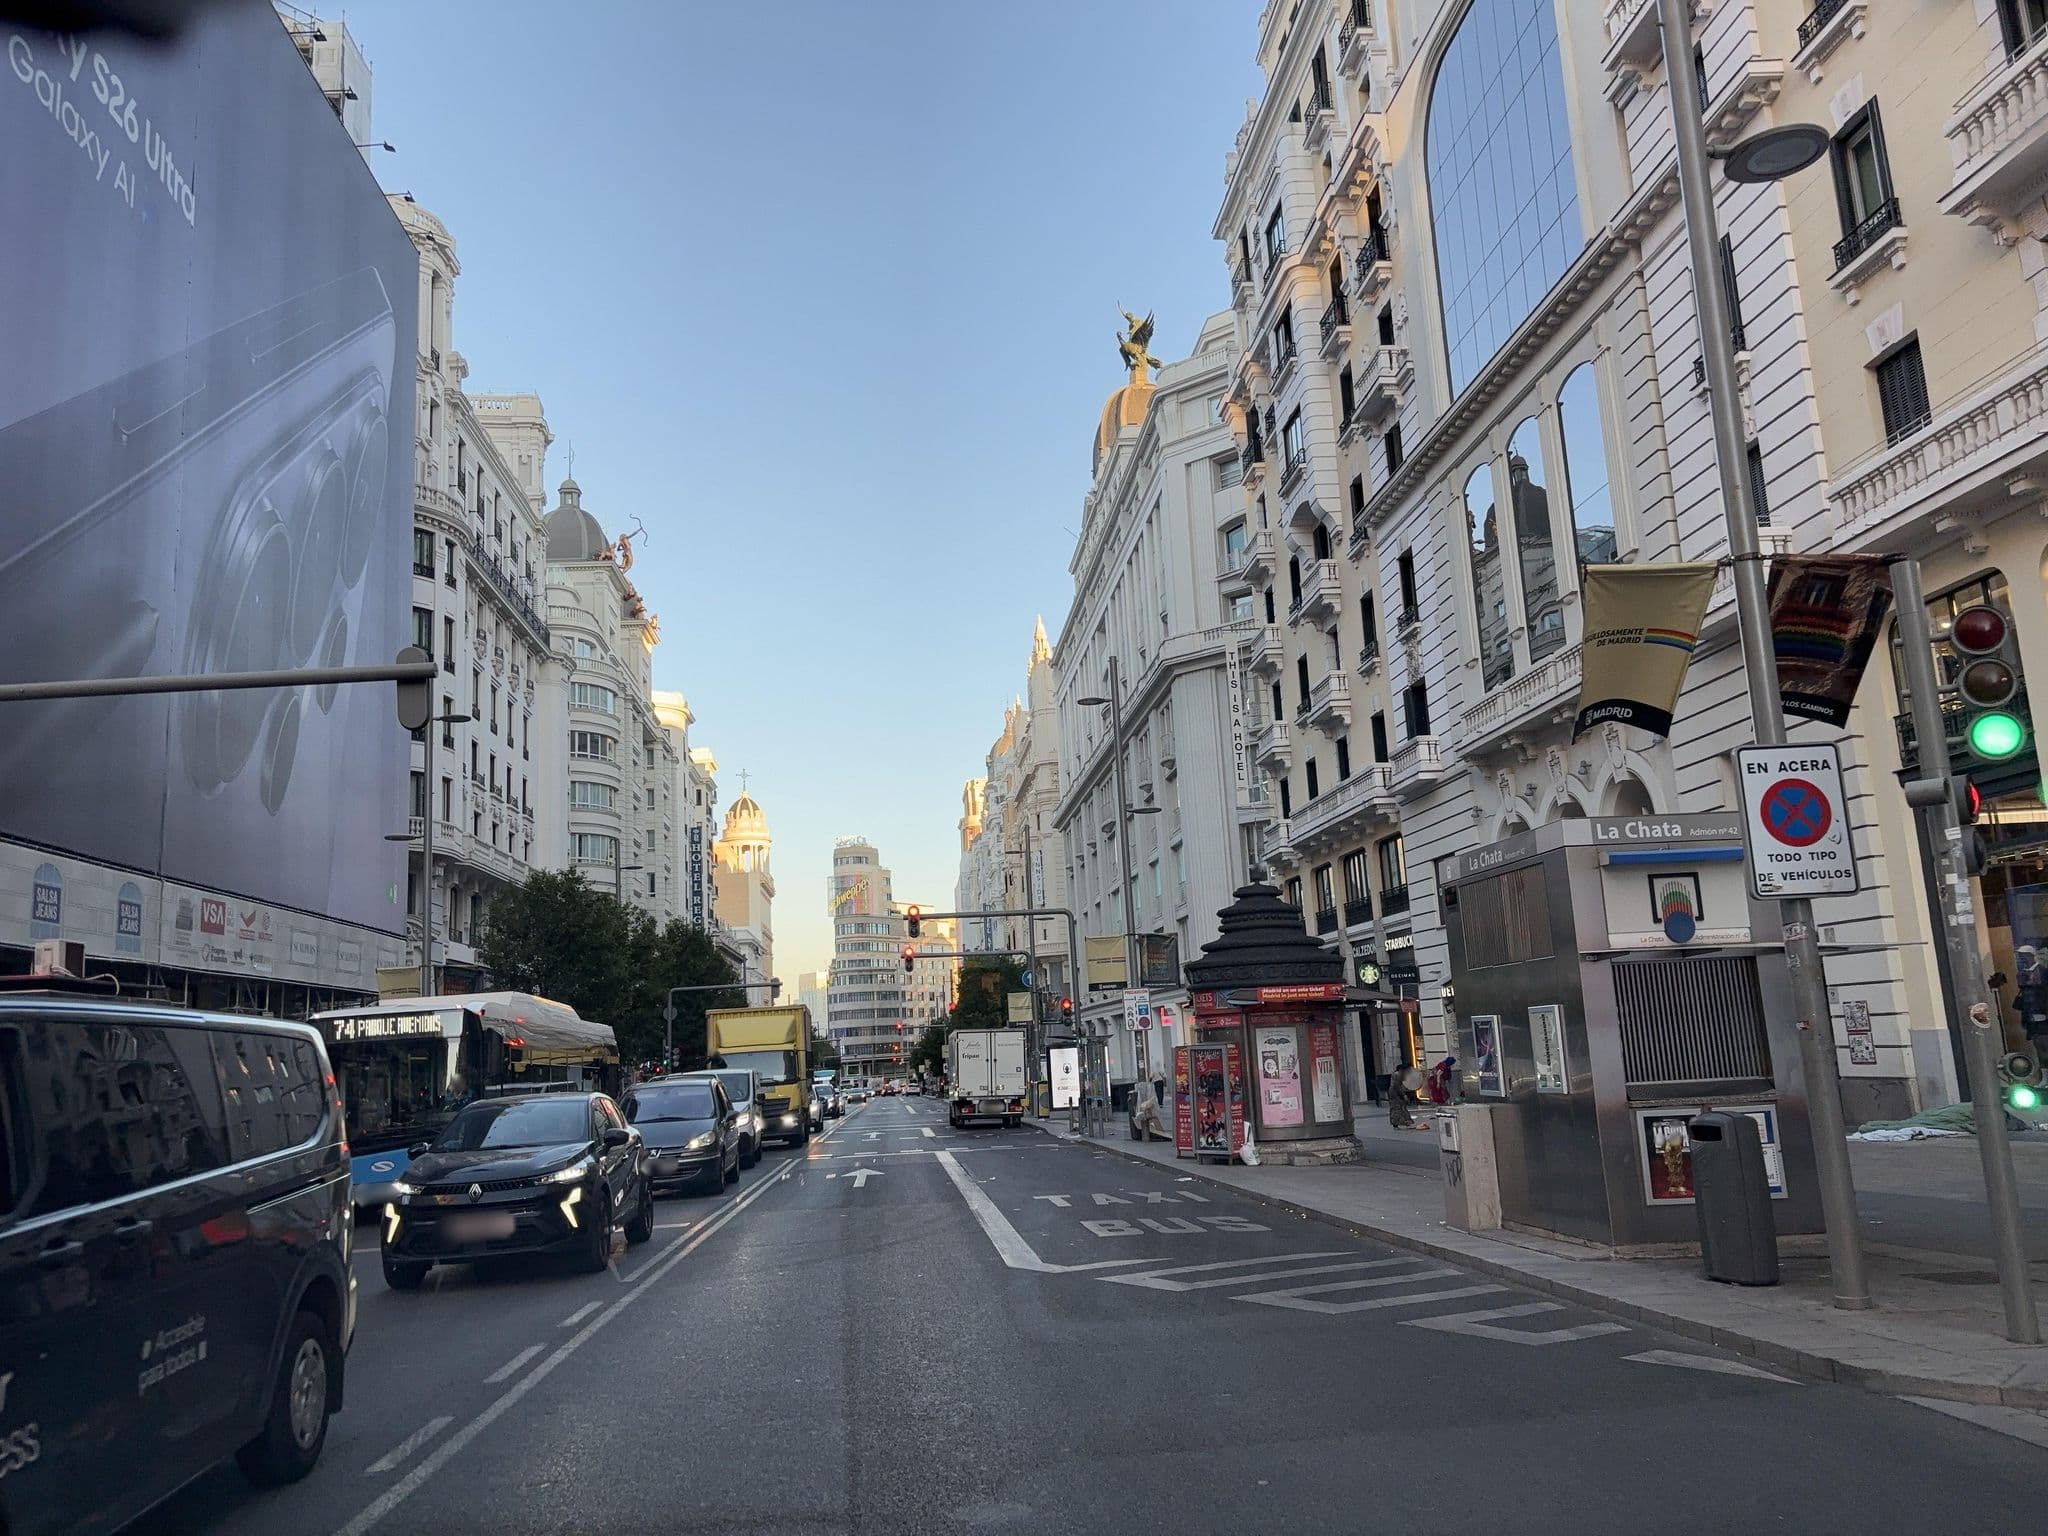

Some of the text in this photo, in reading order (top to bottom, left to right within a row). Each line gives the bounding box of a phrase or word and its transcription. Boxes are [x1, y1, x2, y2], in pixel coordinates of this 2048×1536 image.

[9, 34, 110, 182] Galaxy
[114, 160, 135, 209] AI
[92, 53, 196, 226] S26 Ultra
[1608, 636, 1642, 645] MADRID
[1228, 652, 1245, 781] THIS IS A HOTEL
[1593, 706, 1633, 719] MADRID
[1800, 702, 1834, 716] CAMINOS
[1747, 759, 1832, 774] EN ACERA
[1597, 823, 1620, 840] La
[1625, 820, 1682, 839] Chata
[1728, 826, 1738, 835] 42
[1469, 857, 1479, 871] La
[1480, 849, 1503, 867] Chata
[1768, 850, 1837, 863] TODO TIPO
[692, 843, 701, 892] HOTEL
[1758, 869, 1852, 882] DE VEHÍCULOS
[37, 887, 58, 905] SALSA
[36, 903, 57, 921] JEANS
[121, 903, 139, 919] SALSA
[120, 917, 139, 934] JEANS
[1385, 935, 1414, 952] STARBUCK
[334, 1018, 355, 1040] 74
[1318, 1060, 1333, 1074] VITA
[1033, 1190, 1211, 1207] TAXI
[1080, 1215, 1272, 1238] BUS
